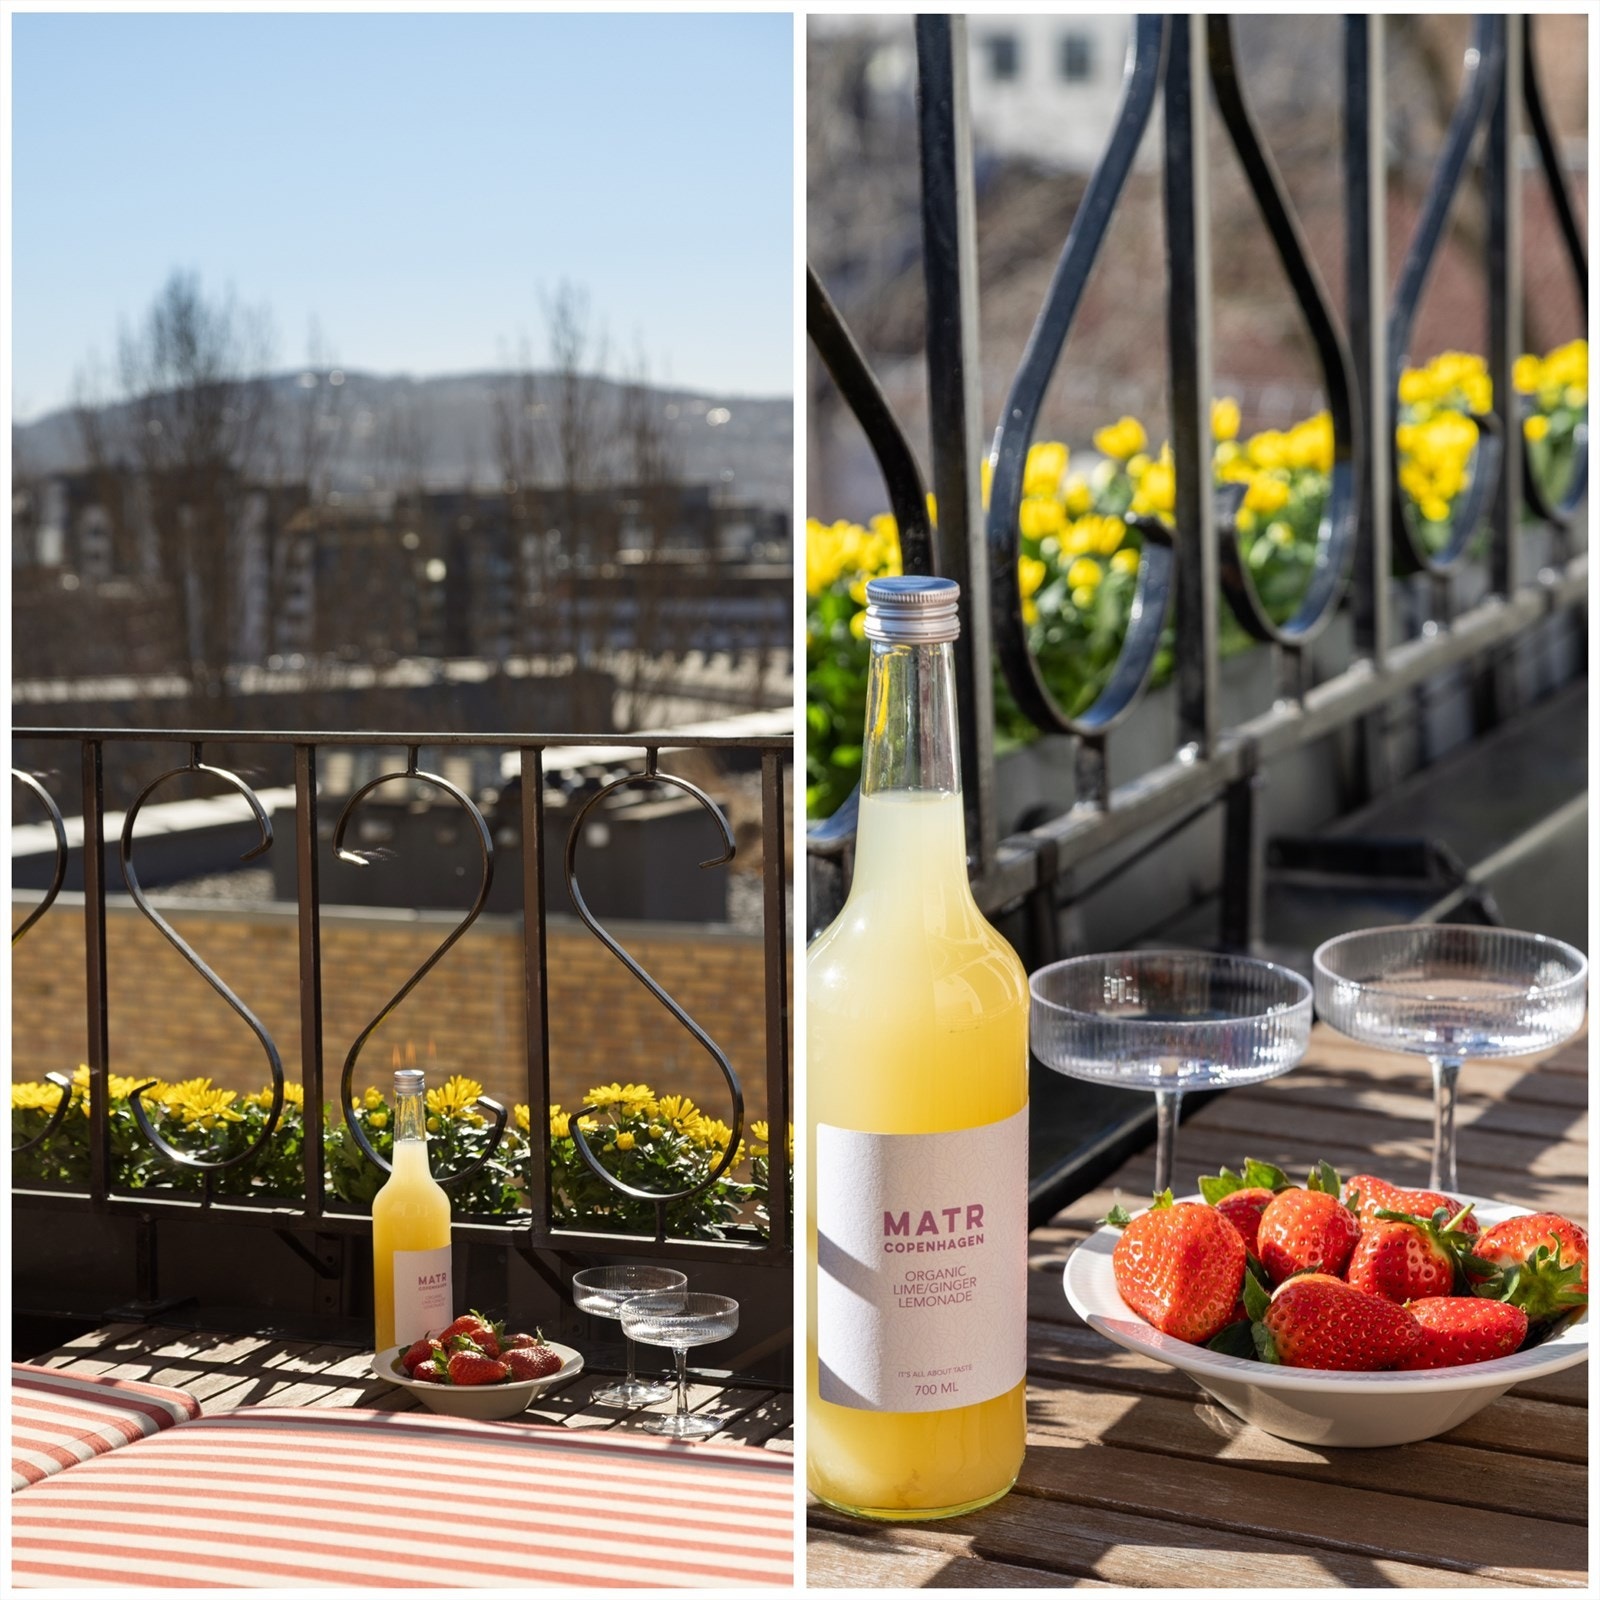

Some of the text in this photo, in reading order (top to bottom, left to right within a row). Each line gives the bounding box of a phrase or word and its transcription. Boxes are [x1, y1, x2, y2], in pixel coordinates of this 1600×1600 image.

[884, 1204, 984, 1236] MATR
[884, 1234, 984, 1253] COPENHAGEN
[418, 1273, 447, 1285] MATR
[905, 1266, 966, 1282] ORGANIC
[893, 1277, 976, 1295] LIME/GINGER
[898, 1291, 972, 1308] LEMONADE
[898, 1364, 973, 1378] IT'S ALL ABOUT TASTE
[914, 1382, 959, 1397] 700 ML
